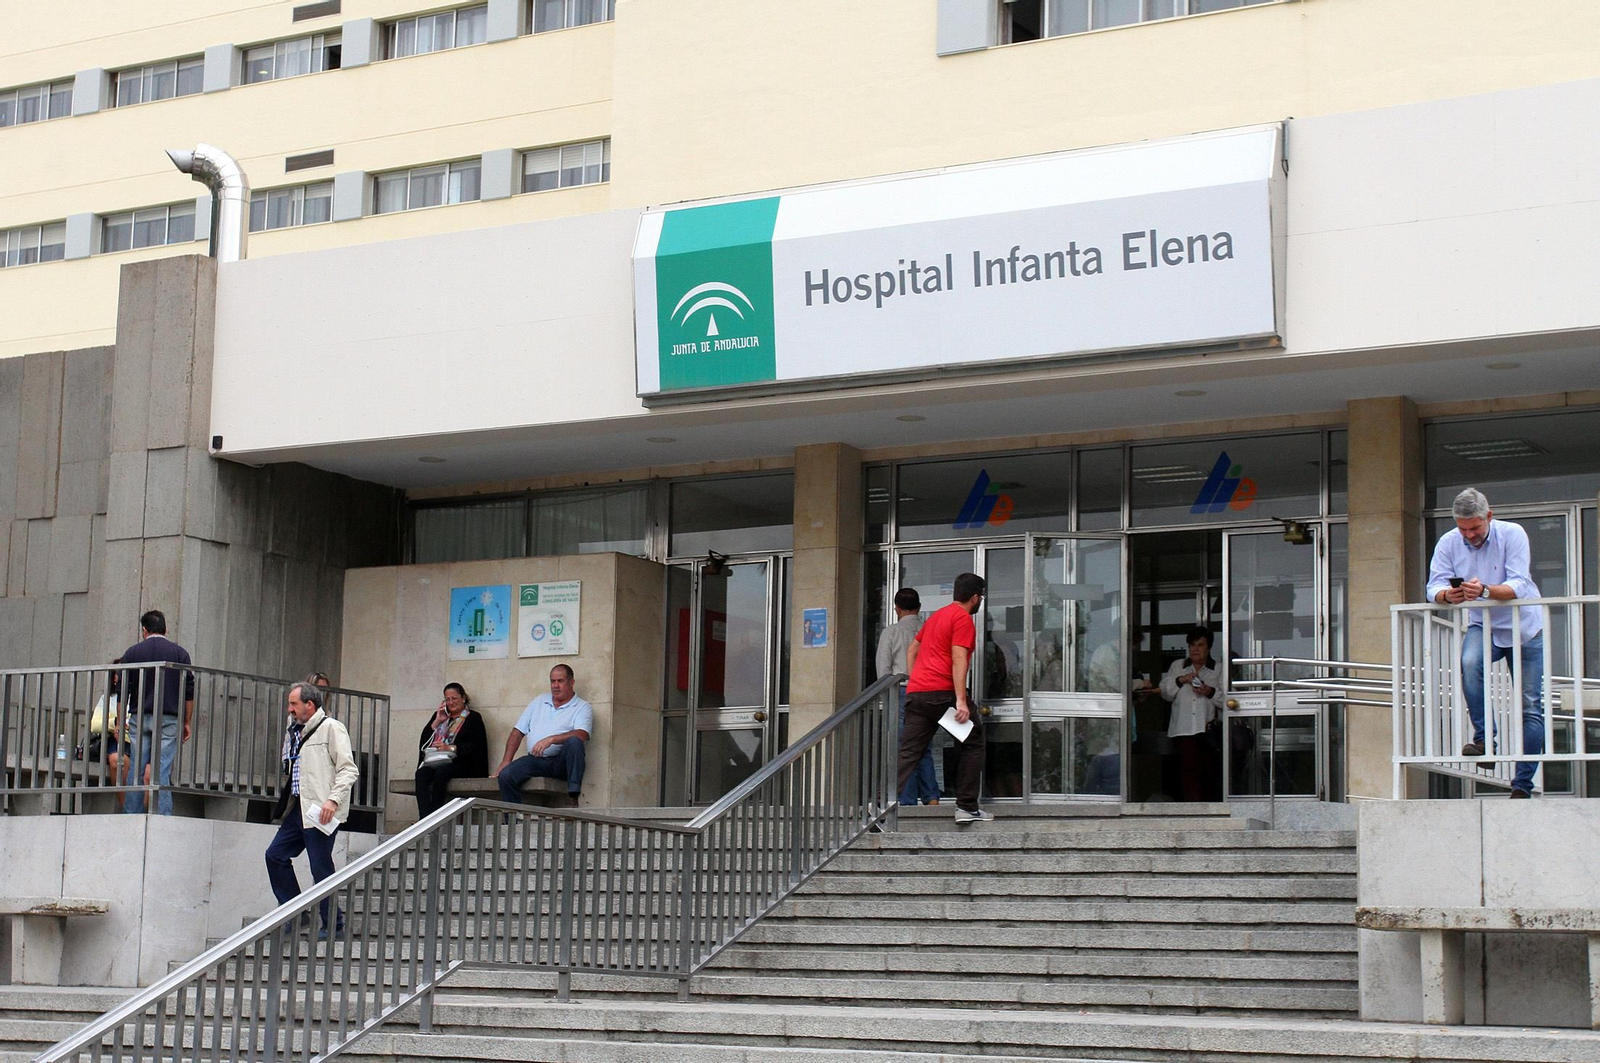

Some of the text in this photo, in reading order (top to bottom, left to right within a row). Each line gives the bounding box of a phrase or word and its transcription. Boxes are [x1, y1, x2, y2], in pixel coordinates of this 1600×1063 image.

[804, 230, 1235, 309] Hospital Infanta Elena
[671, 342, 697, 356] JUNTA
[700, 341, 711, 353] DE
